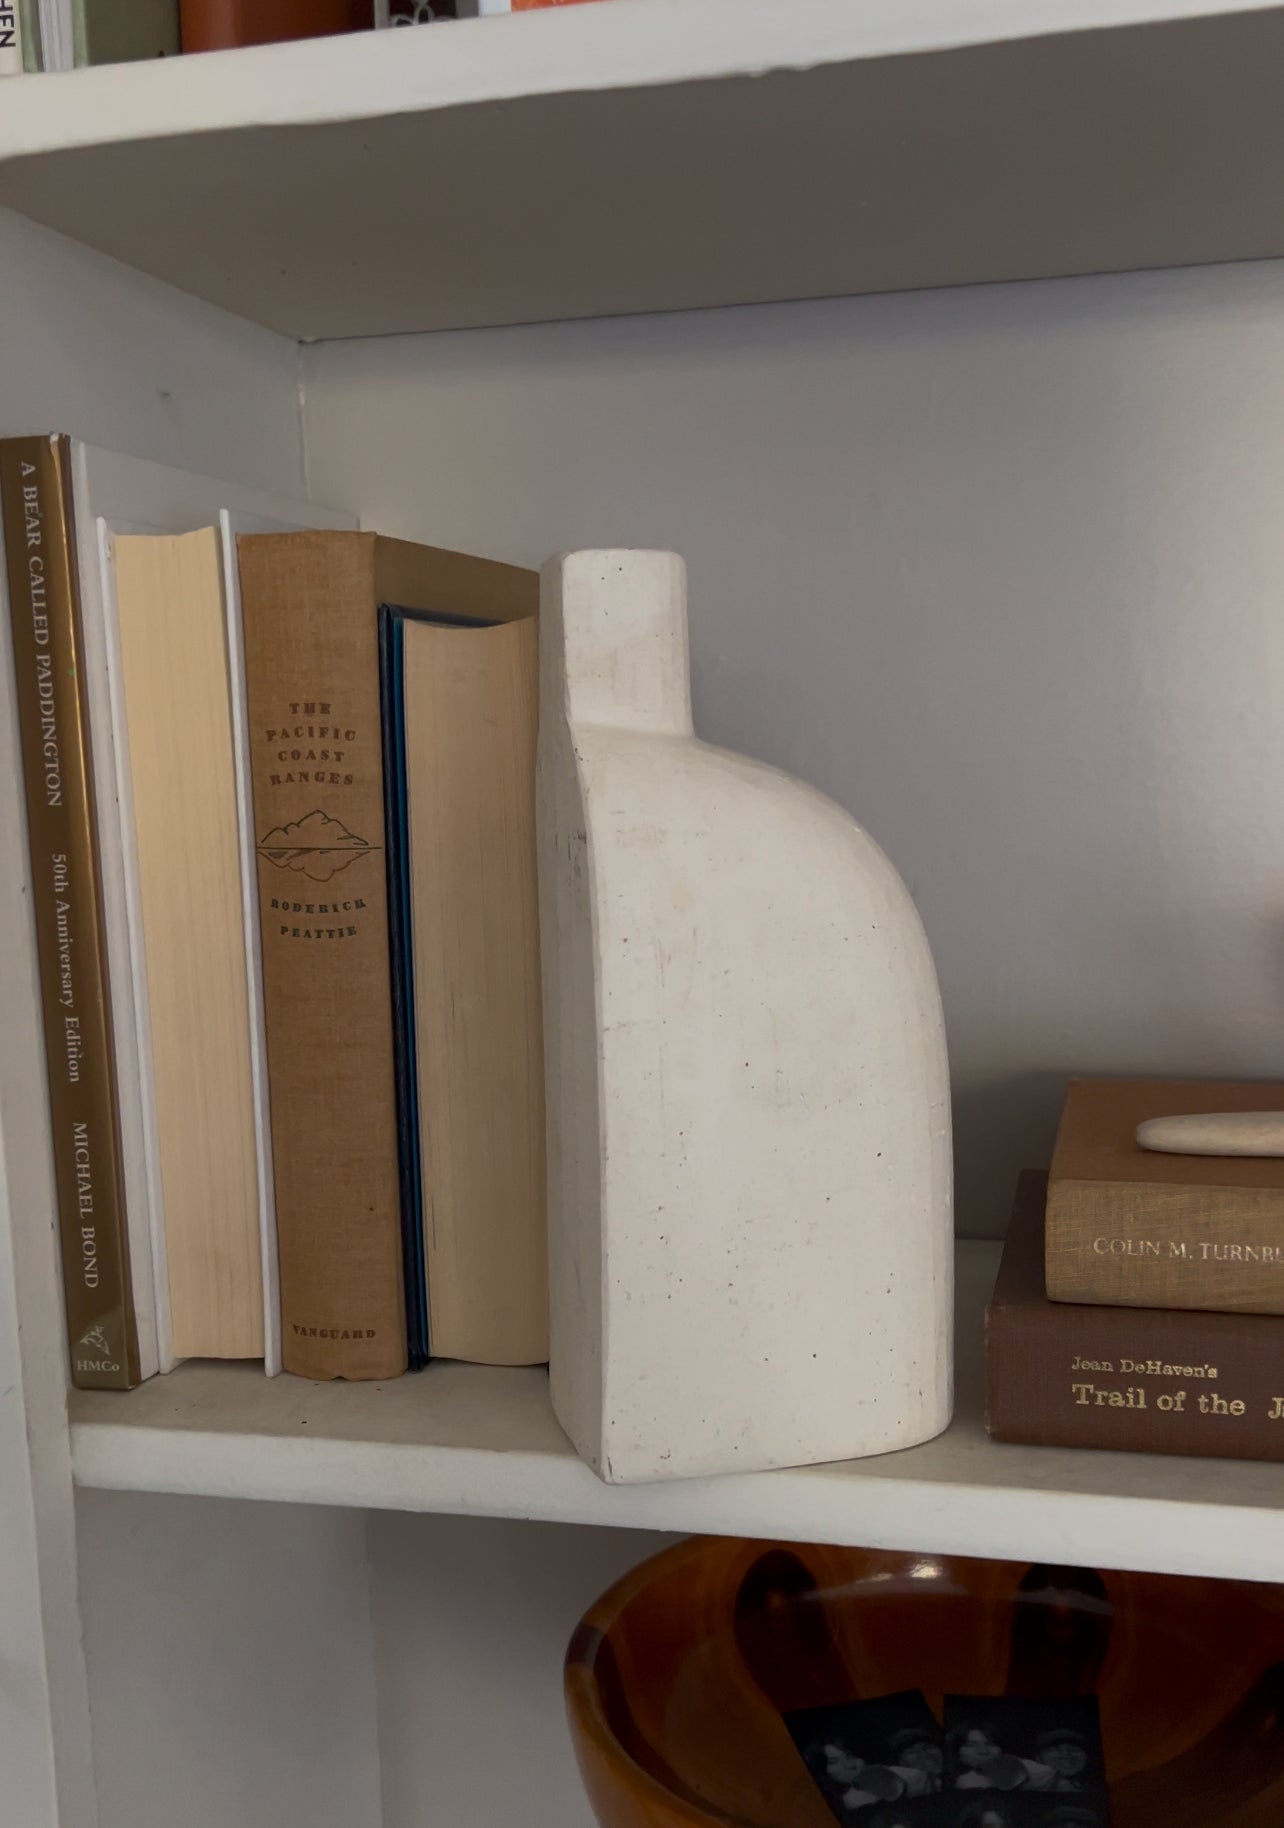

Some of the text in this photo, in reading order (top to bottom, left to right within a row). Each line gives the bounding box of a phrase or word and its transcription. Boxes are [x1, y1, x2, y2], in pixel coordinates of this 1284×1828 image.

[20, 461, 62, 808] A BEAR CALLED PADDINGTON
[289, 702, 332, 715] THE
[265, 725, 356, 742] PACIFIC
[277, 750, 345, 762] COAST
[270, 771, 354, 786] RANGES
[271, 898, 366, 914] RODERICK
[280, 926, 357, 939] PEATTIE
[52, 853, 82, 1083] 50th Anniversary Edition
[73, 1122, 99, 1289] MICHAEL BOND
[1093, 1237, 1160, 1256] COLIN
[1169, 1242, 1193, 1259] M.
[292, 1324, 377, 1340] VANGUARD
[77, 1360, 120, 1371] HMCo
[1071, 1356, 1218, 1379] Jean DeHaven's
[1071, 1383, 1284, 1419] Trail of the J
